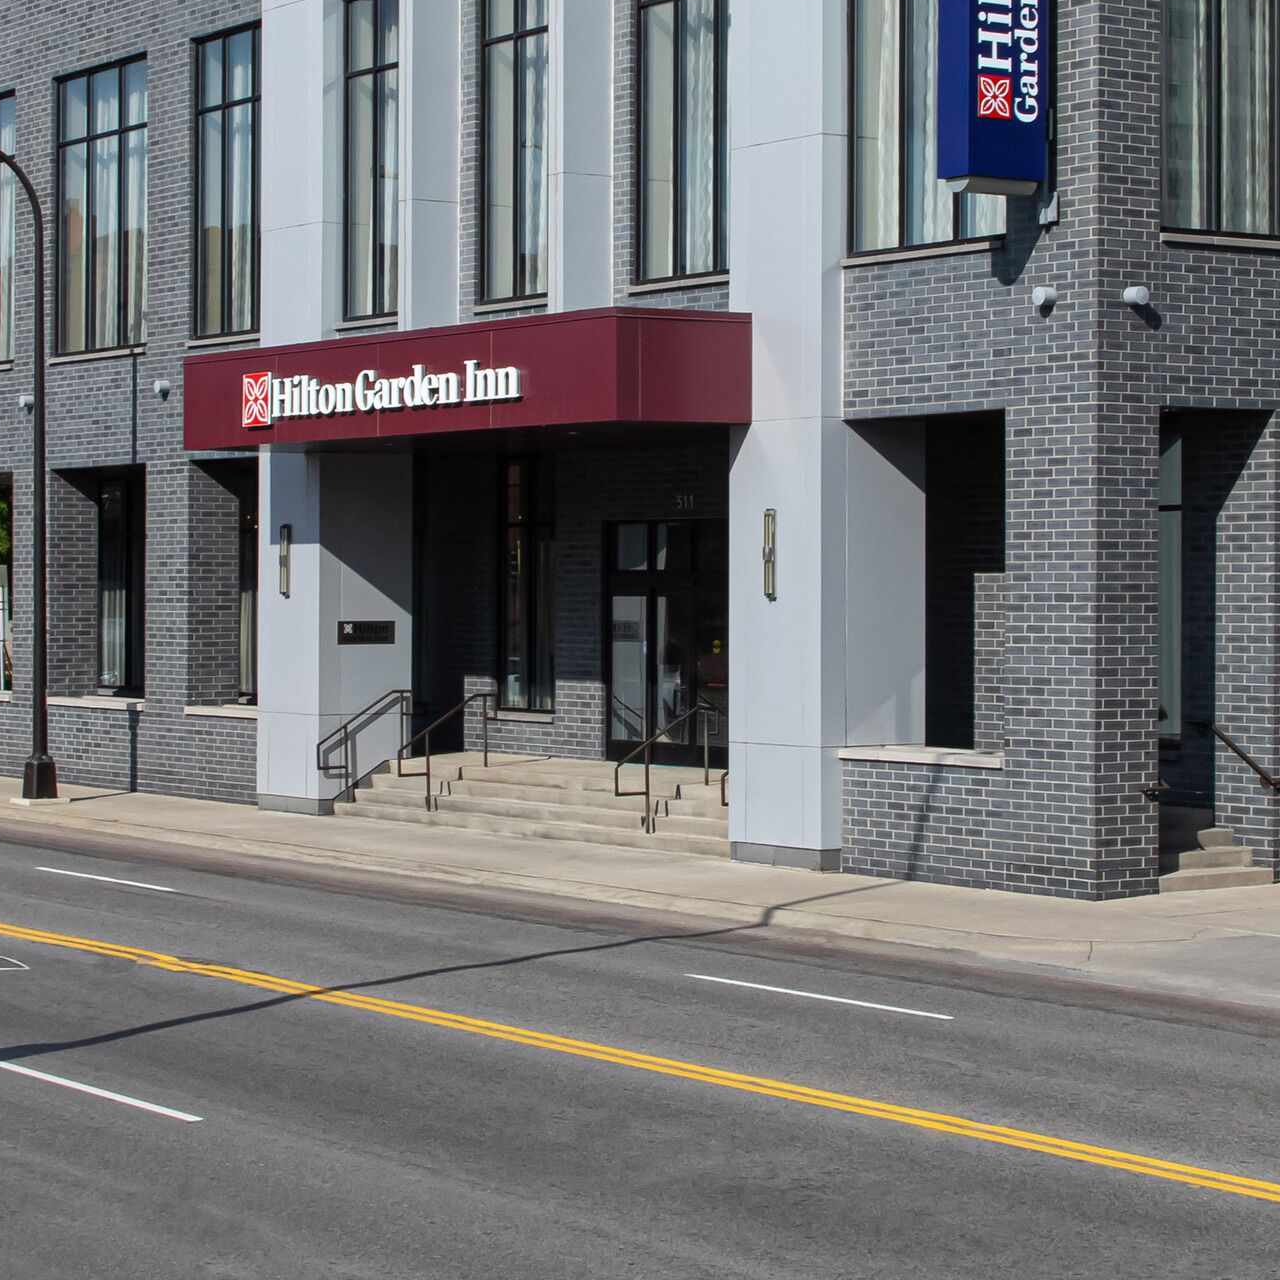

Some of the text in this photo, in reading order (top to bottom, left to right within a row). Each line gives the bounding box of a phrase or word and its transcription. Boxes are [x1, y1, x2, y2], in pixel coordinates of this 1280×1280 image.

[271, 359, 521, 419] Hilton Garden Inn
[677, 495, 695, 509] 511
